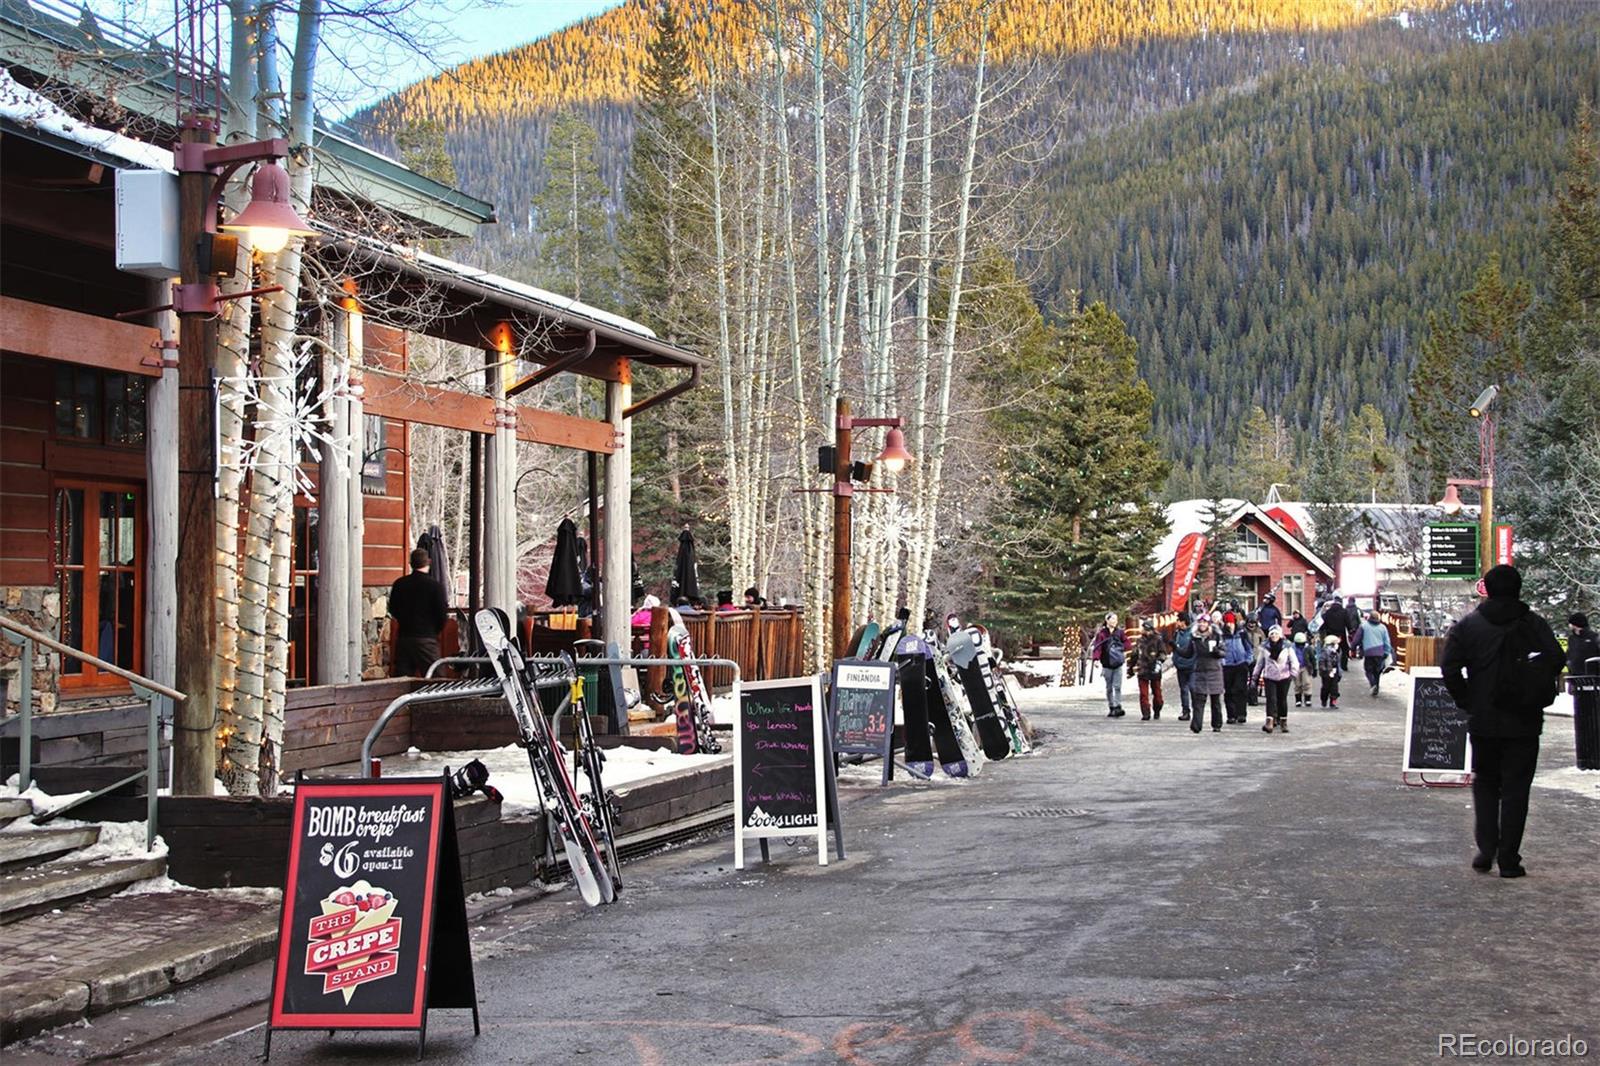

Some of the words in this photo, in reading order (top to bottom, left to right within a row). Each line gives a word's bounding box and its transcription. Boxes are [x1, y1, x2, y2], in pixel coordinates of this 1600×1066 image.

[846, 672, 880, 683] FINLANDIA
[746, 702, 775, 716] When
[308, 806, 357, 837] BOMB
[358, 804, 426, 829] breakfast
[748, 812, 784, 828] Coors
[785, 813, 818, 826] LIGHT
[356, 822, 395, 843] crepe
[319, 840, 360, 879] $6
[363, 846, 413, 858] available
[362, 859, 403, 872] open-11
[316, 913, 351, 931] THE
[313, 927, 394, 963] CREPE
[332, 960, 391, 985] STAND
